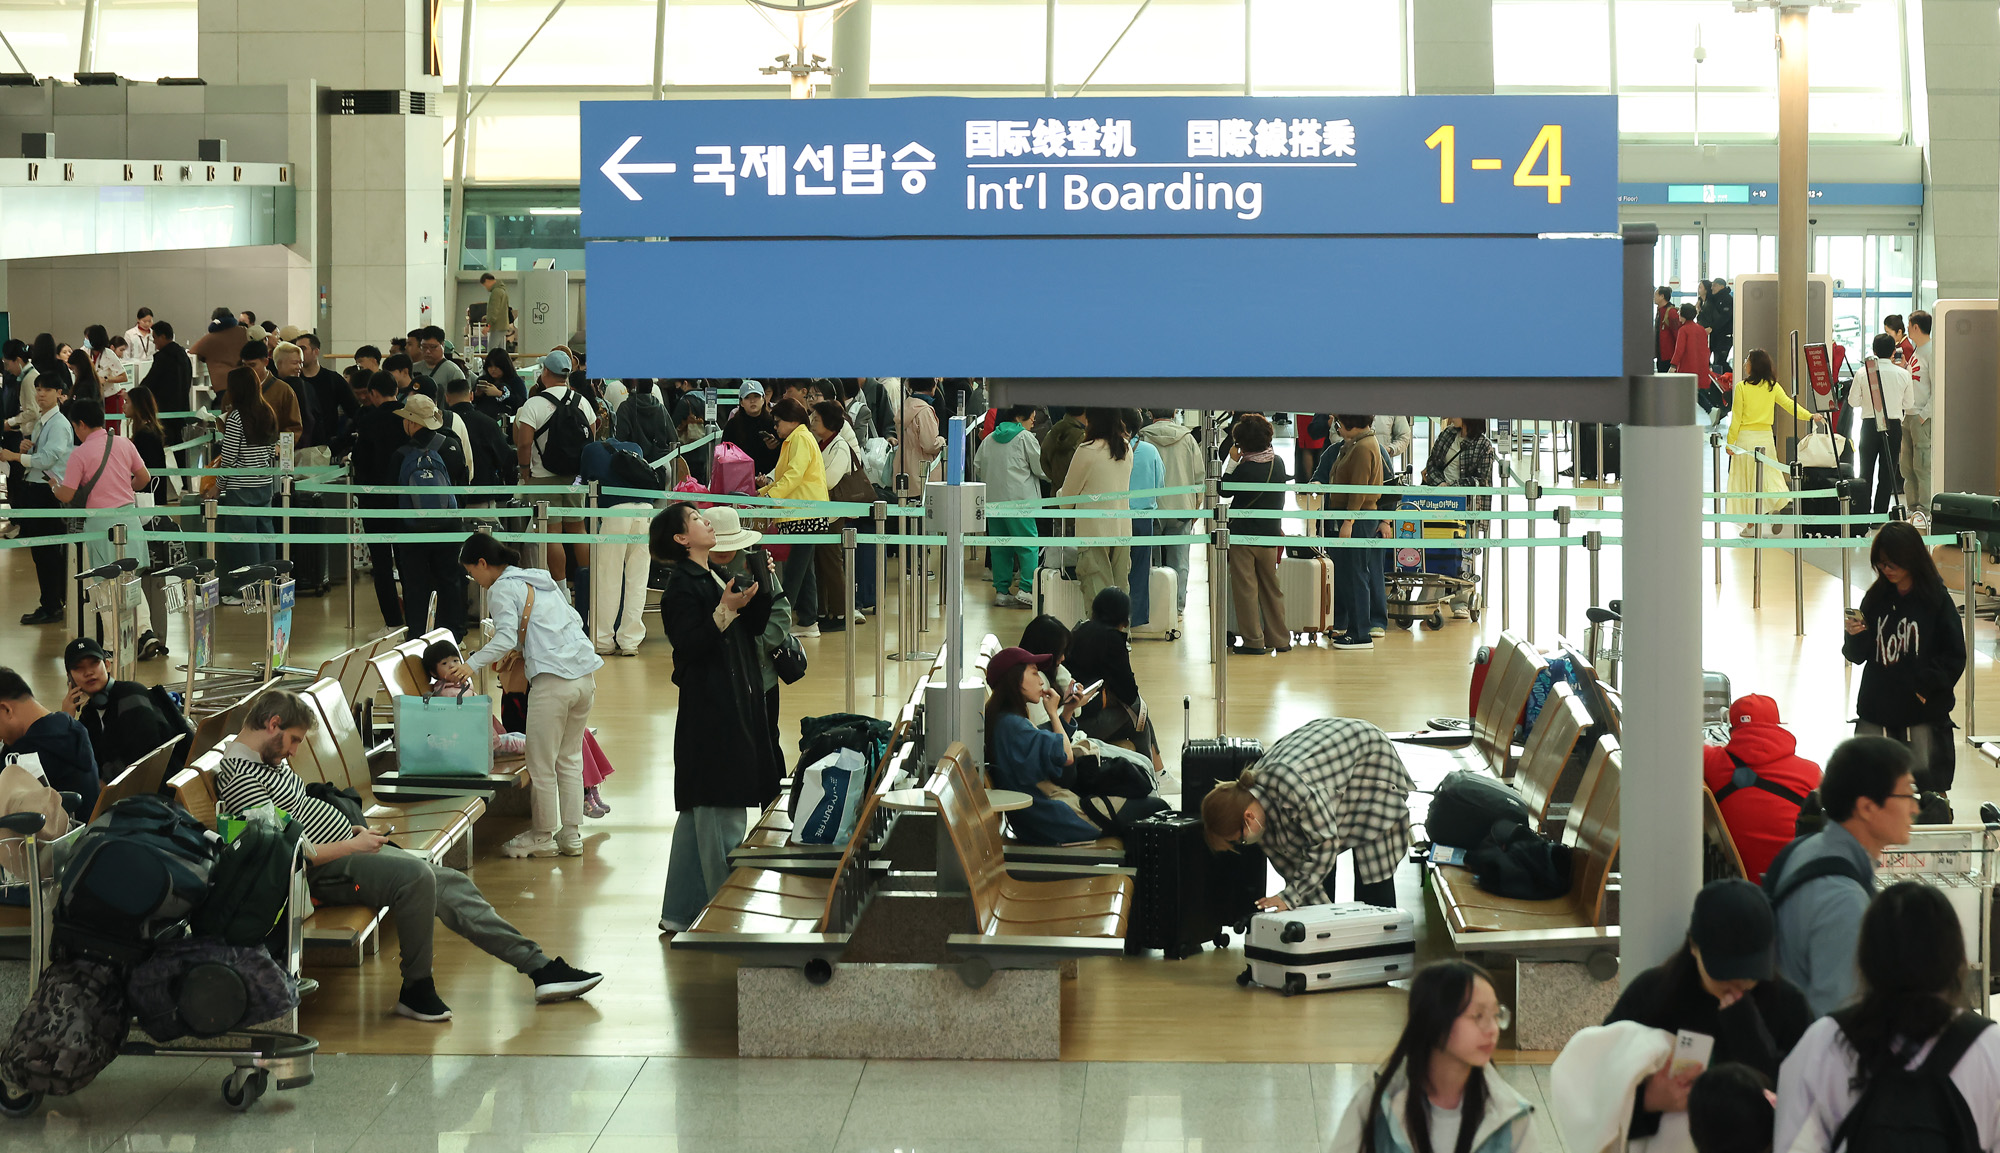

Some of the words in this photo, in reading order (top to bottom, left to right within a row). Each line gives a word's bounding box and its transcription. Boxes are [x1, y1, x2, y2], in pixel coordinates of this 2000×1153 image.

[965, 118, 1136, 158] 国际线登机
[693, 141, 937, 196] 국제선탑승
[1063, 171, 1263, 220] Boarding
[822, 804, 835, 825] DUTY
